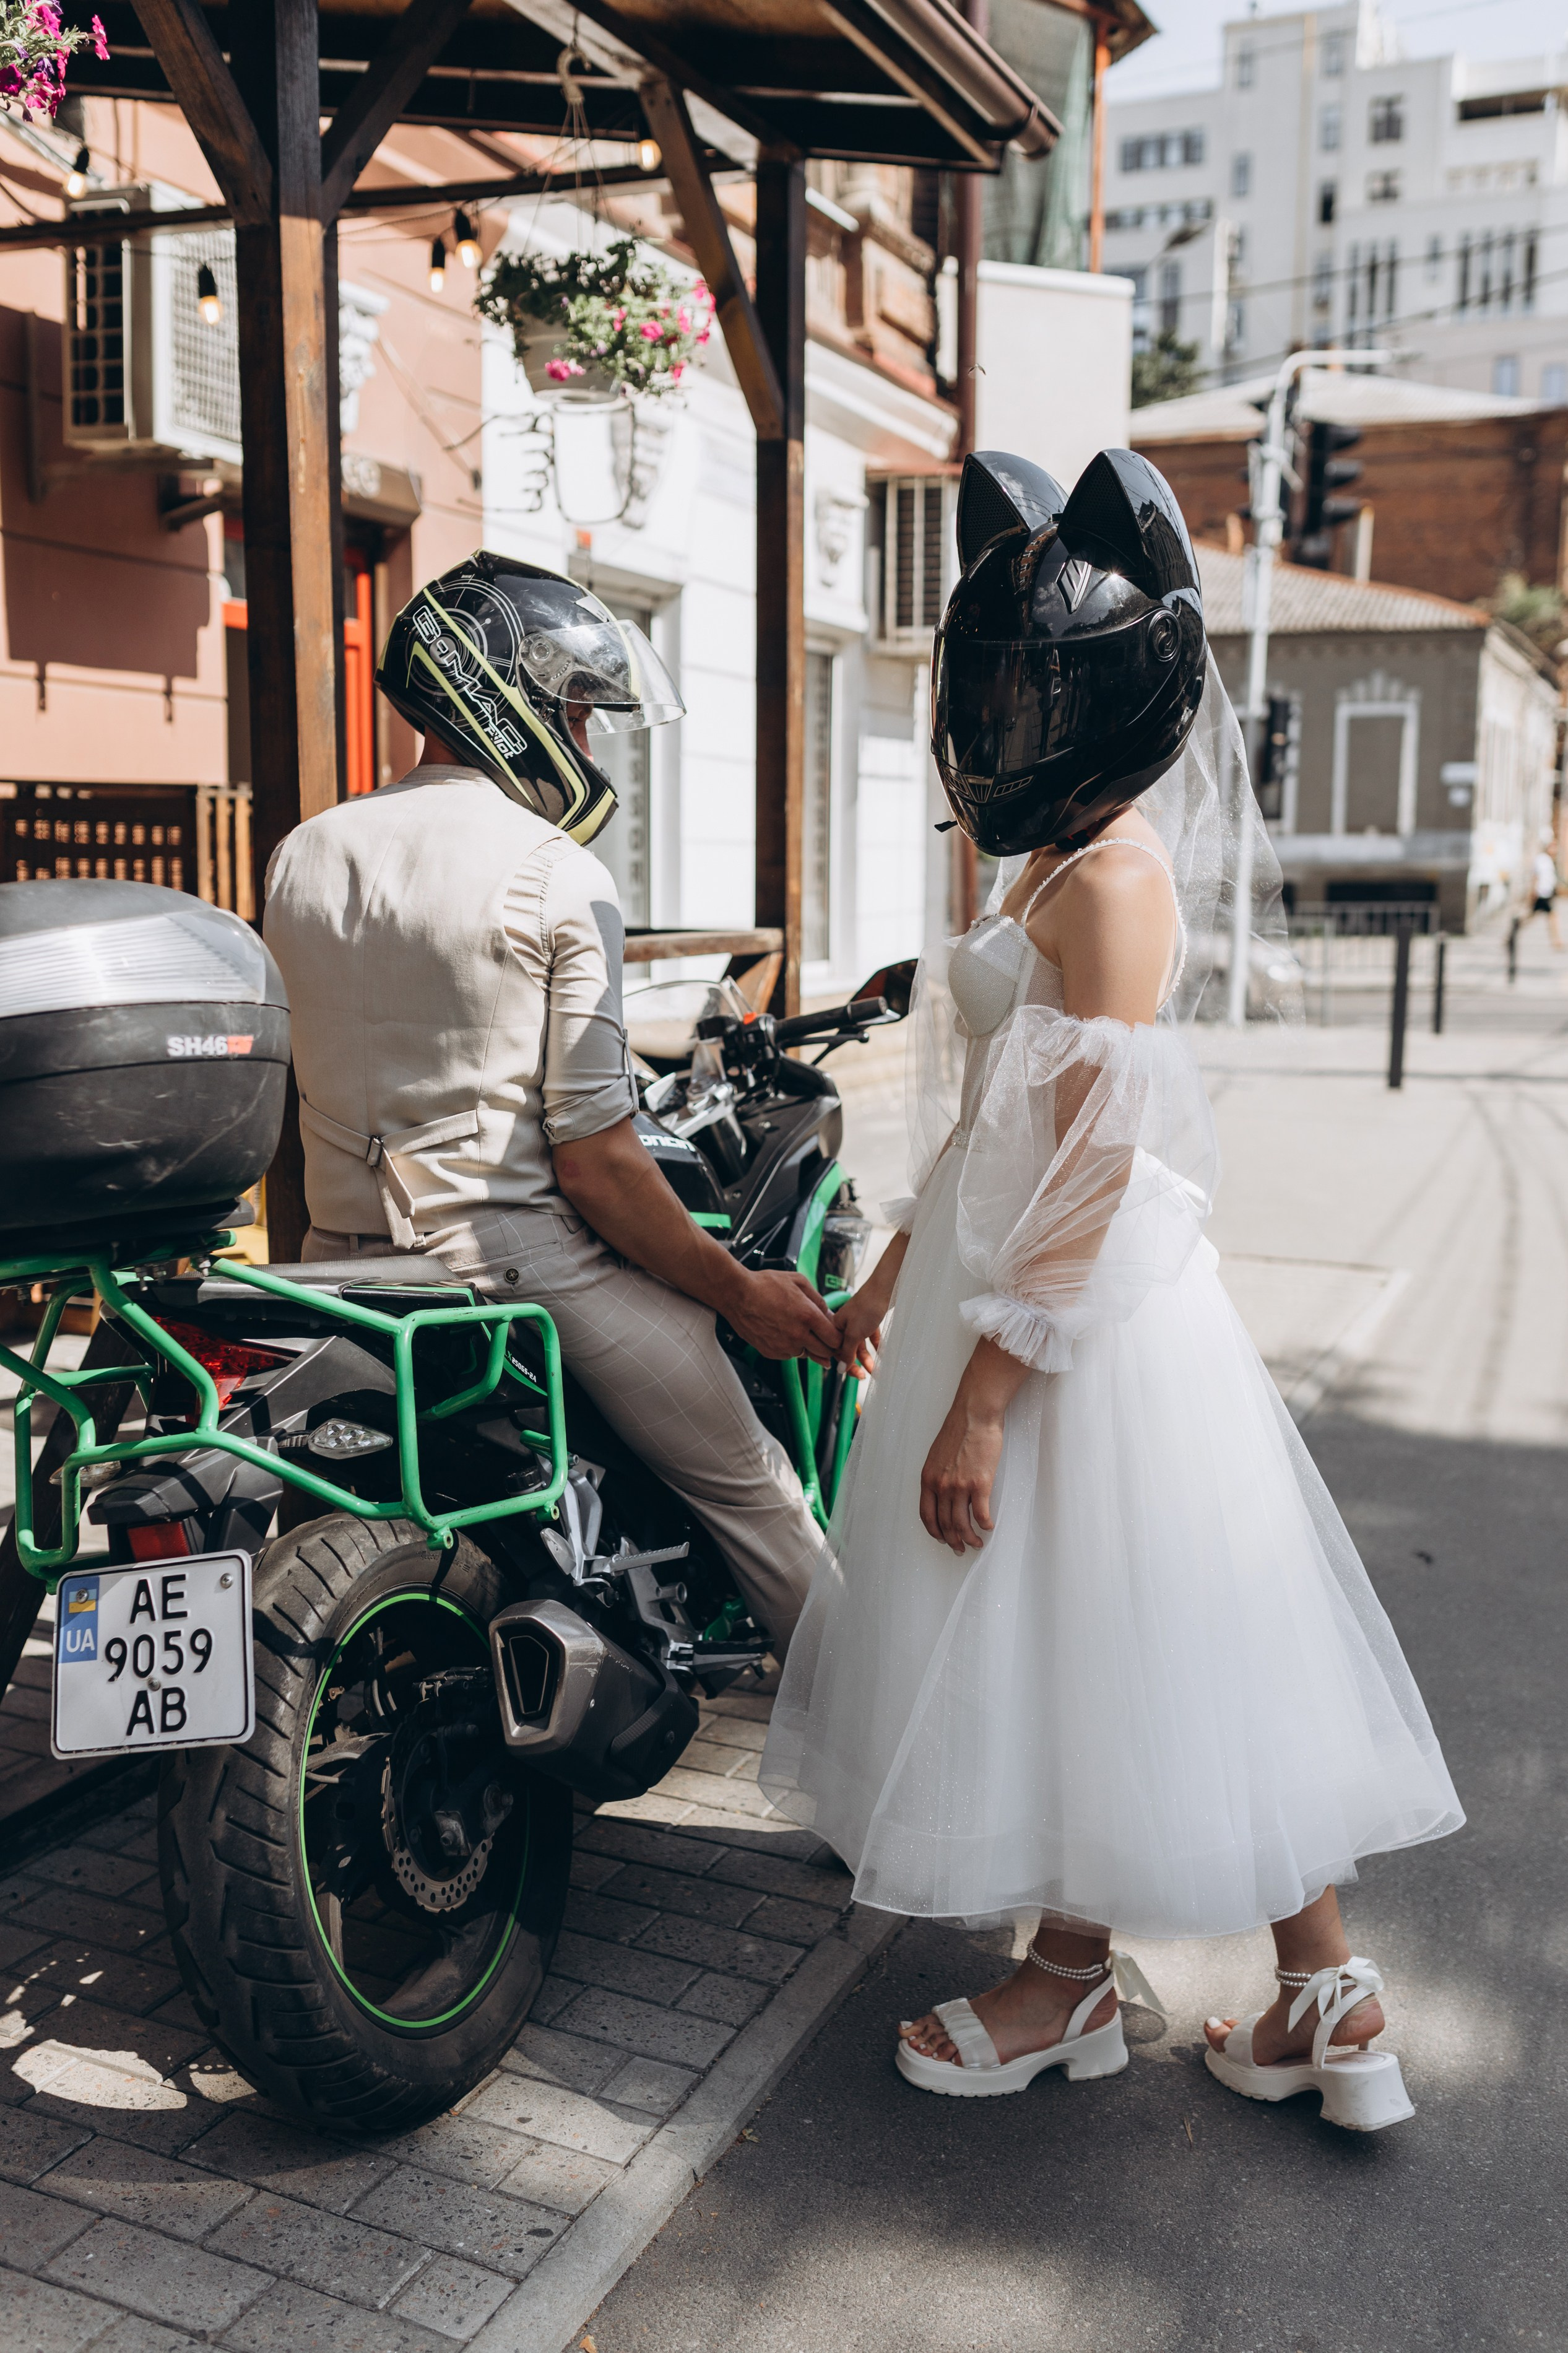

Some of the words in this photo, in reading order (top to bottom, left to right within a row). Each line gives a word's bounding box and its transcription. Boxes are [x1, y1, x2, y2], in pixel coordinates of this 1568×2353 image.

[483, 723, 514, 759] Pilot
[167, 1036, 228, 1056] SH46
[129, 1574, 188, 1624] AE
[66, 1628, 95, 1653] UA
[105, 1628, 212, 1682] 9059
[126, 1687, 188, 1736] AB
